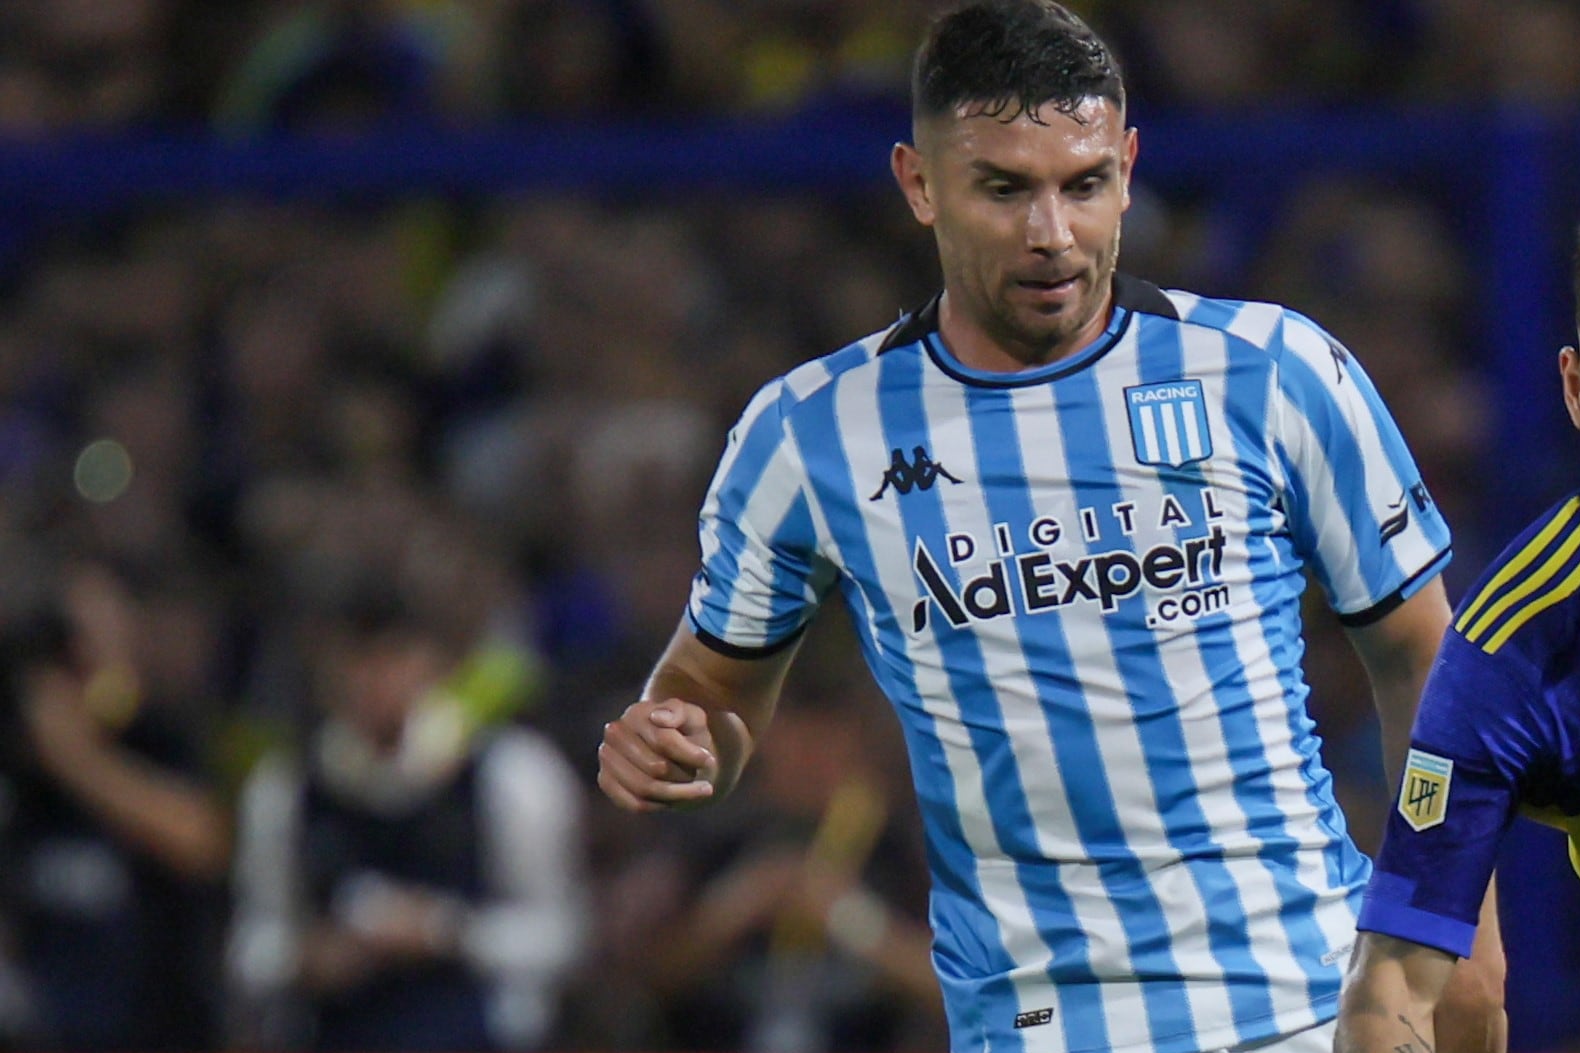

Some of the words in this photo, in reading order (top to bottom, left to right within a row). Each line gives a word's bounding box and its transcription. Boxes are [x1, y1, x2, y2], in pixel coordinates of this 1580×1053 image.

[1131, 386, 1197, 404] RACING
[950, 488, 1223, 563] DIGITAL
[1148, 585, 1229, 626] .com
